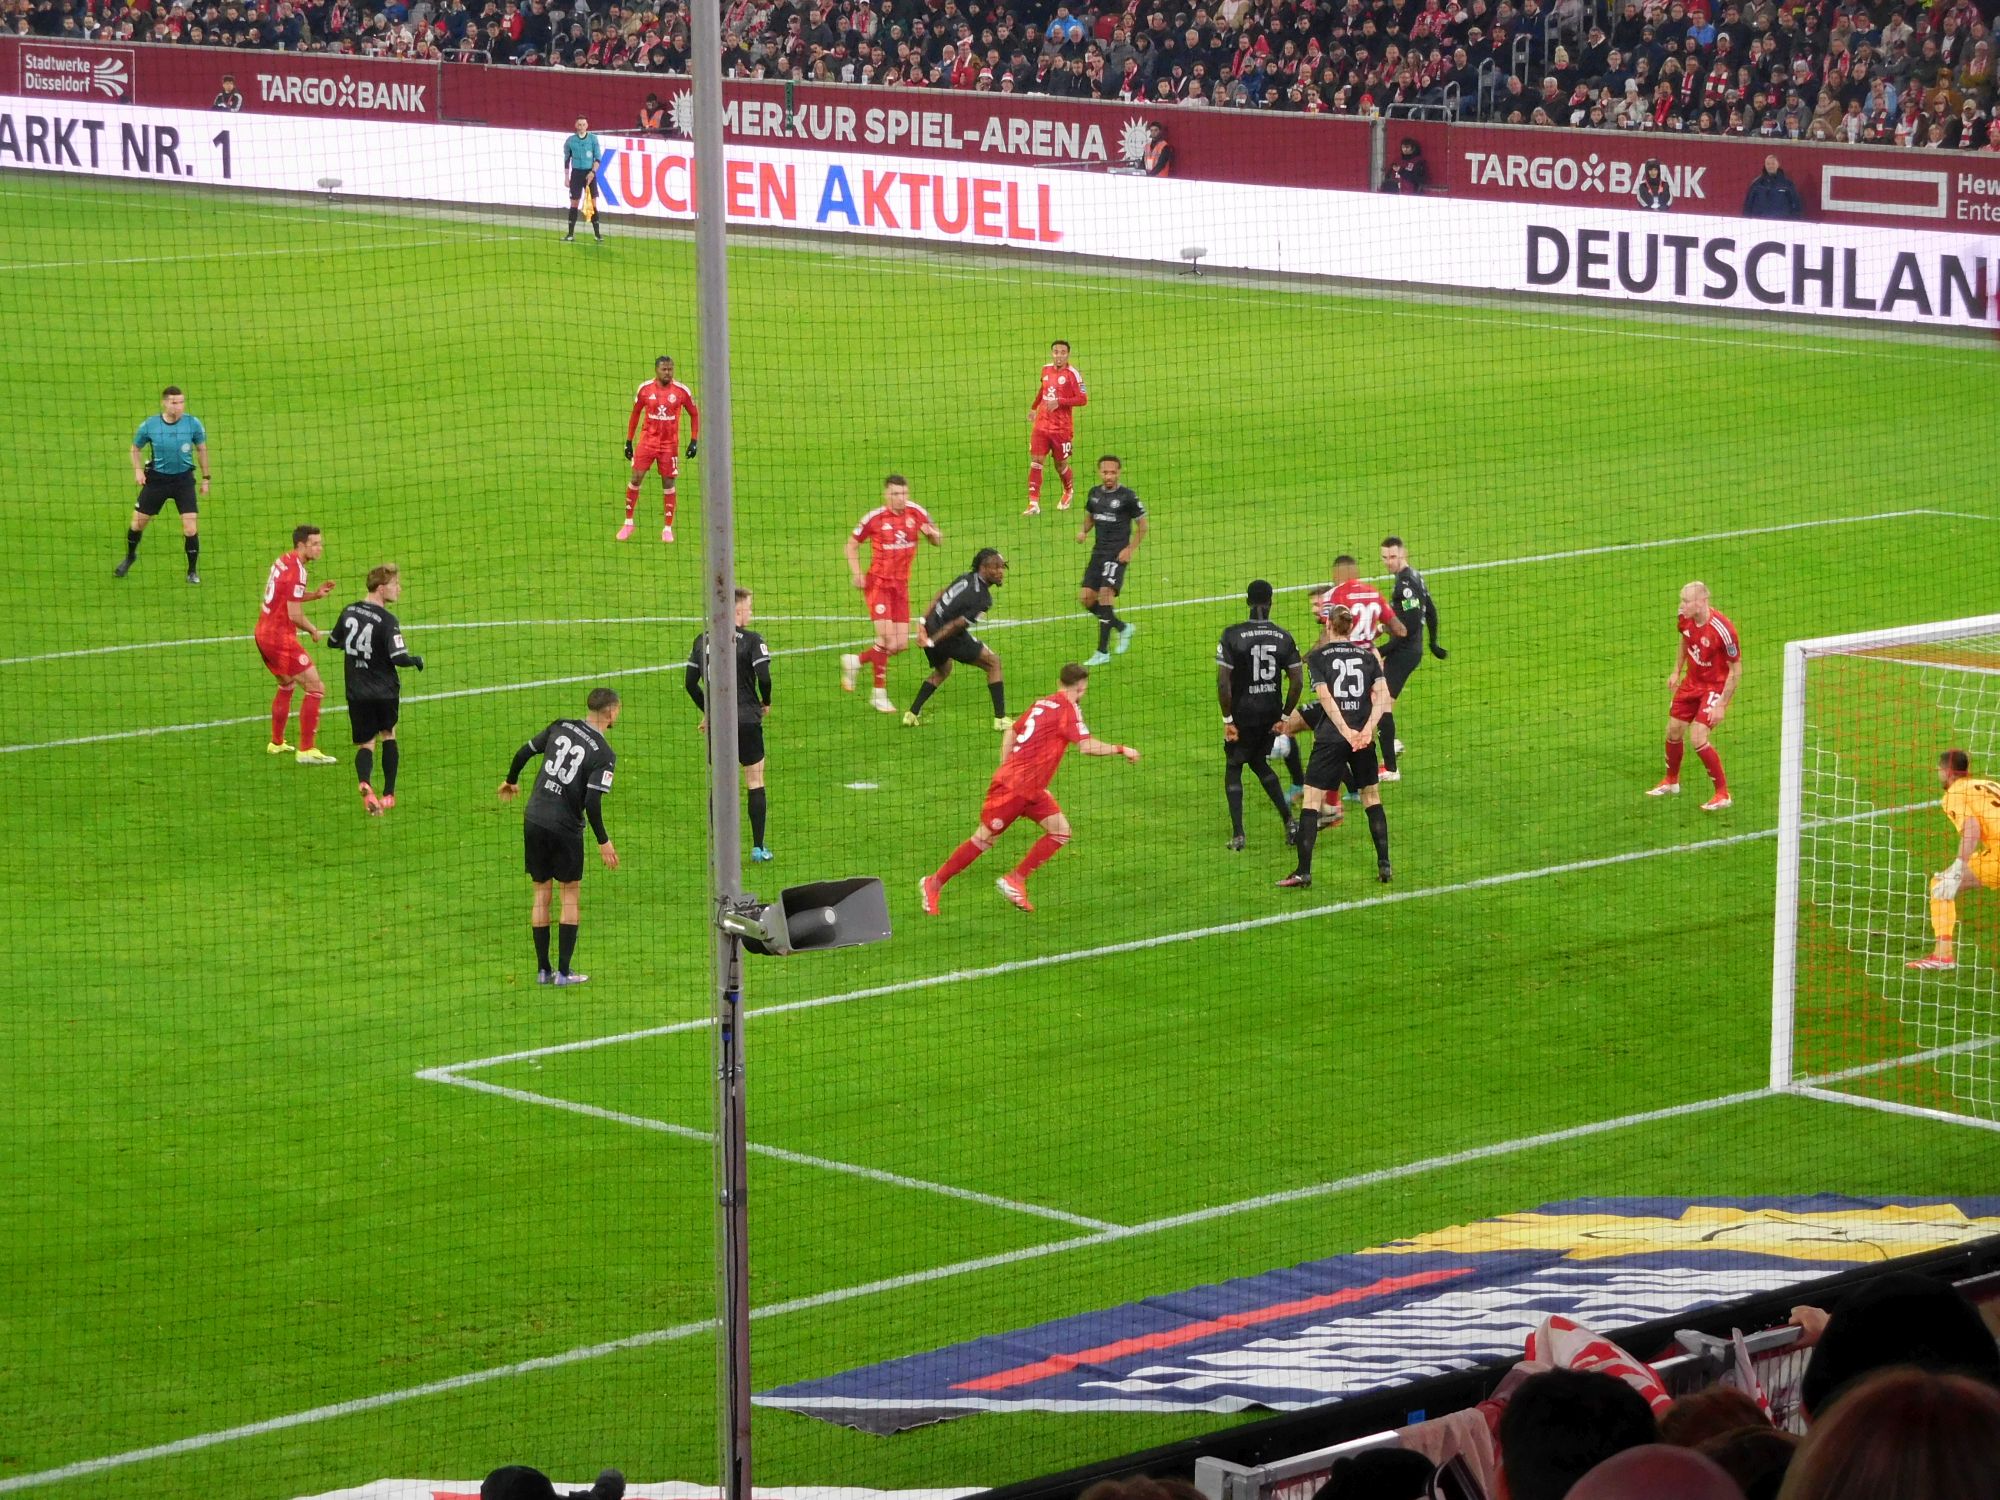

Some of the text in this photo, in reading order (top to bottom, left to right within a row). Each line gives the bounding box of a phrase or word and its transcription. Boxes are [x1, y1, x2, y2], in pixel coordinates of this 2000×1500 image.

[25, 53, 91, 73] Stadtwerke
[25, 72, 91, 93] Düsseldorf
[0, 113, 231, 179] ARKT NR. 1
[863, 107, 1108, 160] SPIEL-ARENA
[596, 138, 1065, 243] KÜCEN AKTUELL
[1957, 173, 2000, 196] Hew
[1957, 199, 2000, 222] Ente
[1526, 224, 2000, 321] DEUTSCHLAN
[345, 616, 374, 660] 24
[1349, 601, 1382, 642] 20
[1250, 644, 1277, 682] 15
[1332, 657, 1365, 698] 25
[1016, 707, 1044, 744] 5
[544, 735, 586, 785] 33
